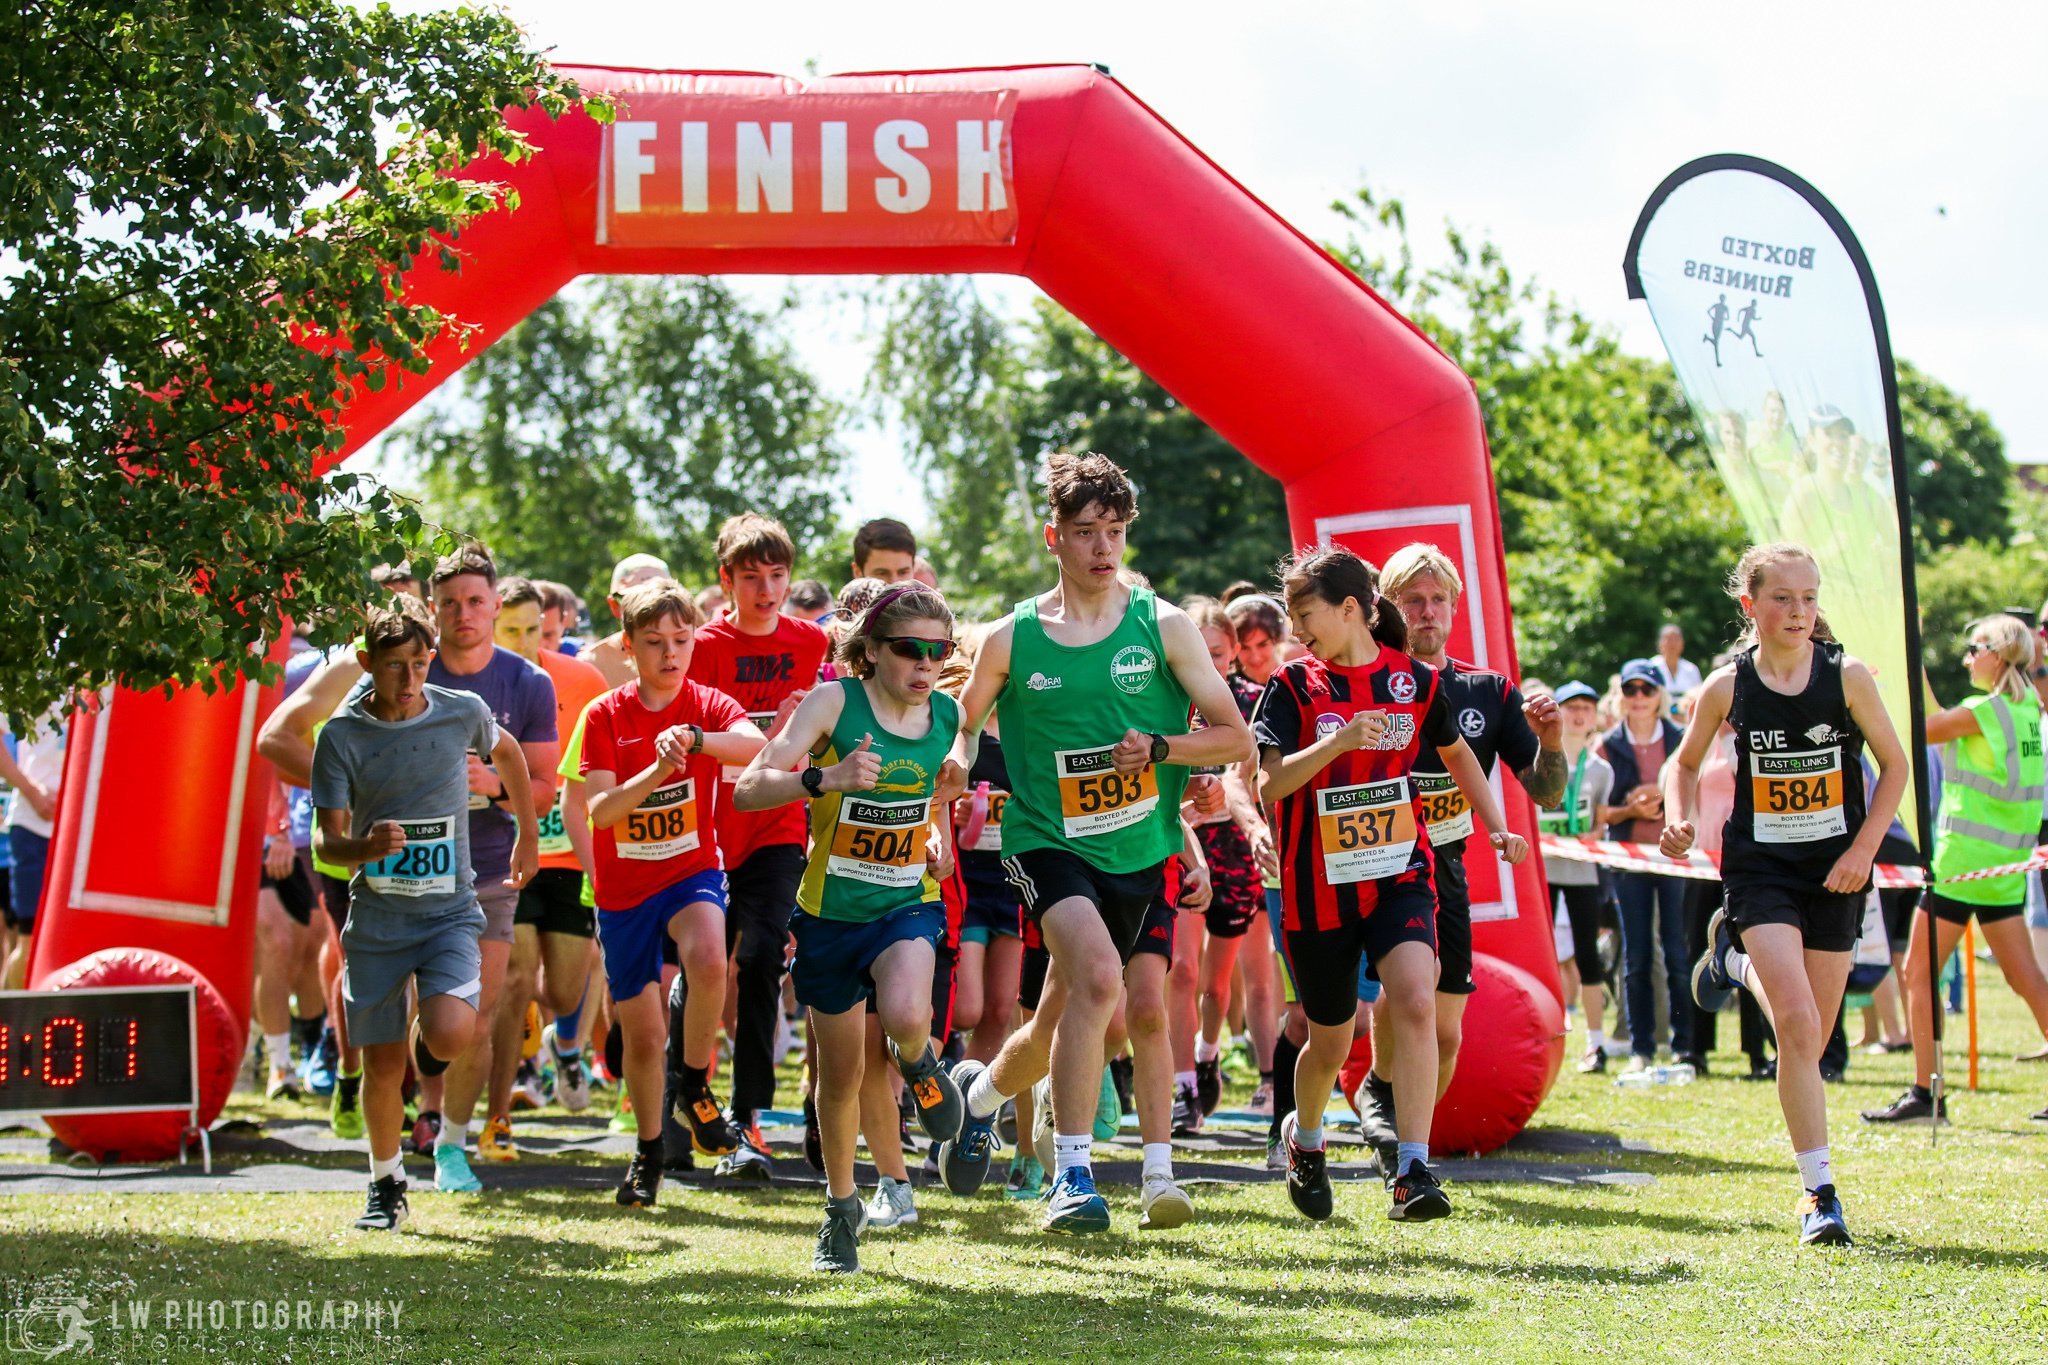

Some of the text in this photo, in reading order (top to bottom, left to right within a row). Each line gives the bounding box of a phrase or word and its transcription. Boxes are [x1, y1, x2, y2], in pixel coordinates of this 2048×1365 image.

[613, 119, 1008, 214] FINISH
[1122, 674, 1147, 683] CHAC
[1750, 730, 1788, 751] EVE
[1072, 755, 1100, 767] EAST
[1764, 756, 1828, 768] EAST LINKS
[879, 759, 928, 779] harnwood
[660, 788, 683, 800] LINKS
[1079, 774, 1142, 812] 593
[1332, 786, 1395, 804] EAST LINKS
[1769, 777, 1830, 812] 584
[857, 806, 920, 818] EAST LINKS
[1420, 791, 1464, 822] 585
[1094, 813, 1120, 822] BOXTED
[416, 825, 441, 835] LINKS
[628, 808, 684, 842] 508
[1076, 823, 1106, 833] SUPPORTED
[1338, 809, 1396, 849] 537
[1830, 825, 1842, 834] 584
[850, 829, 914, 864] 504
[378, 844, 450, 877] 1280
[1353, 850, 1377, 859] BOXTED
[858, 862, 886, 873] BOXTED
[1335, 860, 1364, 869] SUPPORTED
[837, 866, 867, 877] SUPPORTED
[875, 874, 899, 882] BOXTED
